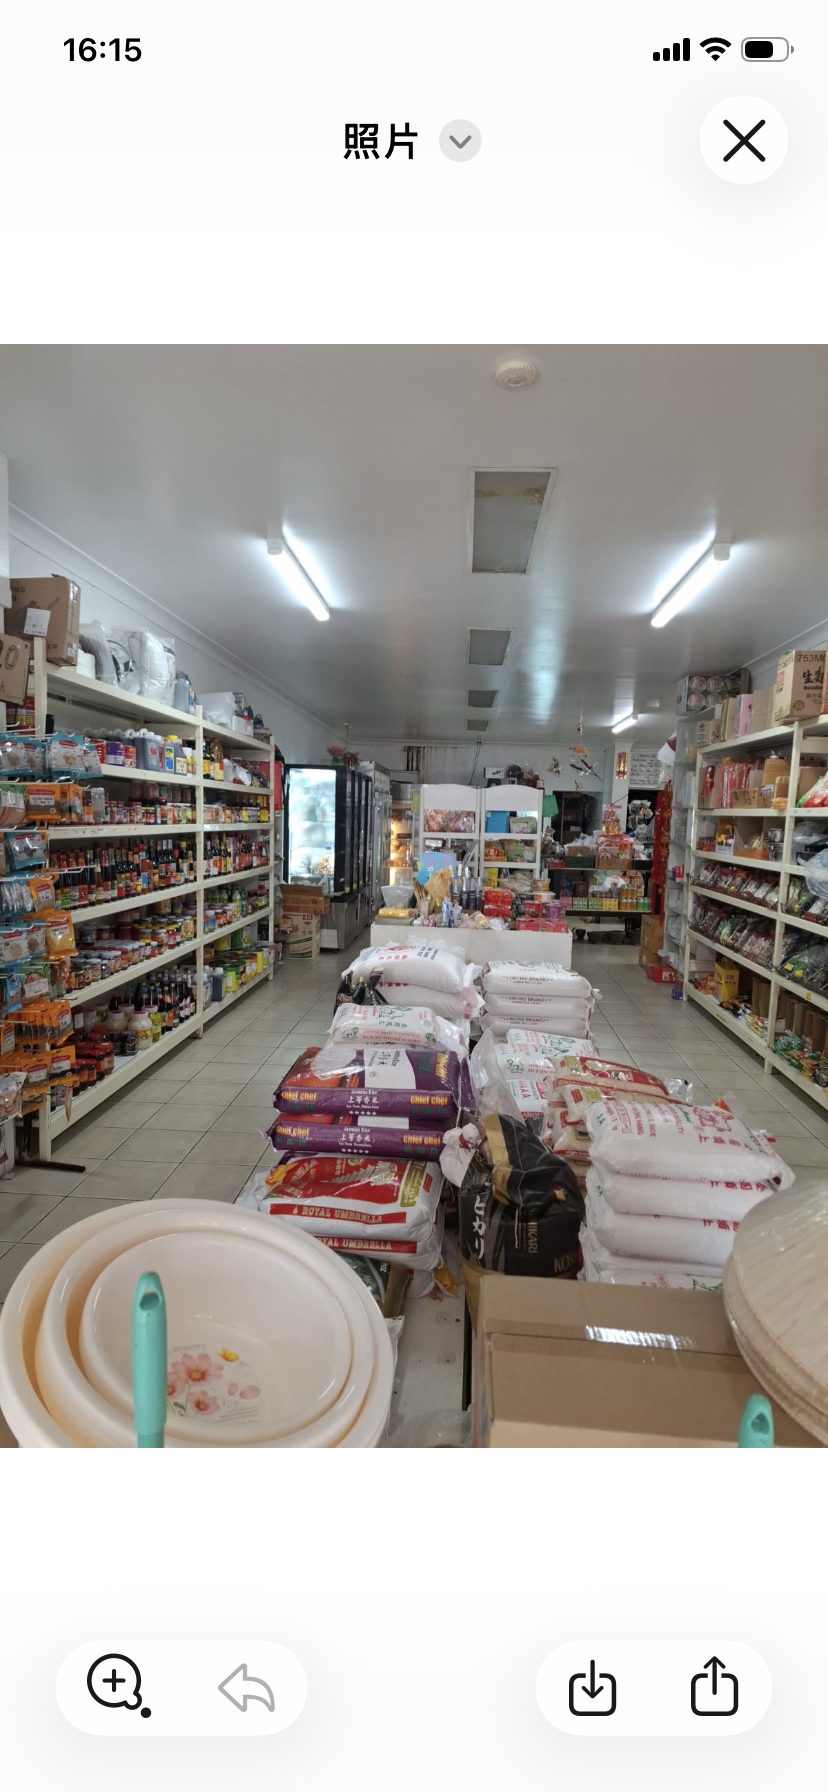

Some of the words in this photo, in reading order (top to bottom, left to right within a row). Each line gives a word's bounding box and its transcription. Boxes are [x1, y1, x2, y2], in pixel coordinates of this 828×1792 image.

[302, 1206, 331, 1218] ROYAL
[334, 1209, 382, 1223] UMBRELLA
[342, 1238, 392, 1251] UMBRELLA
